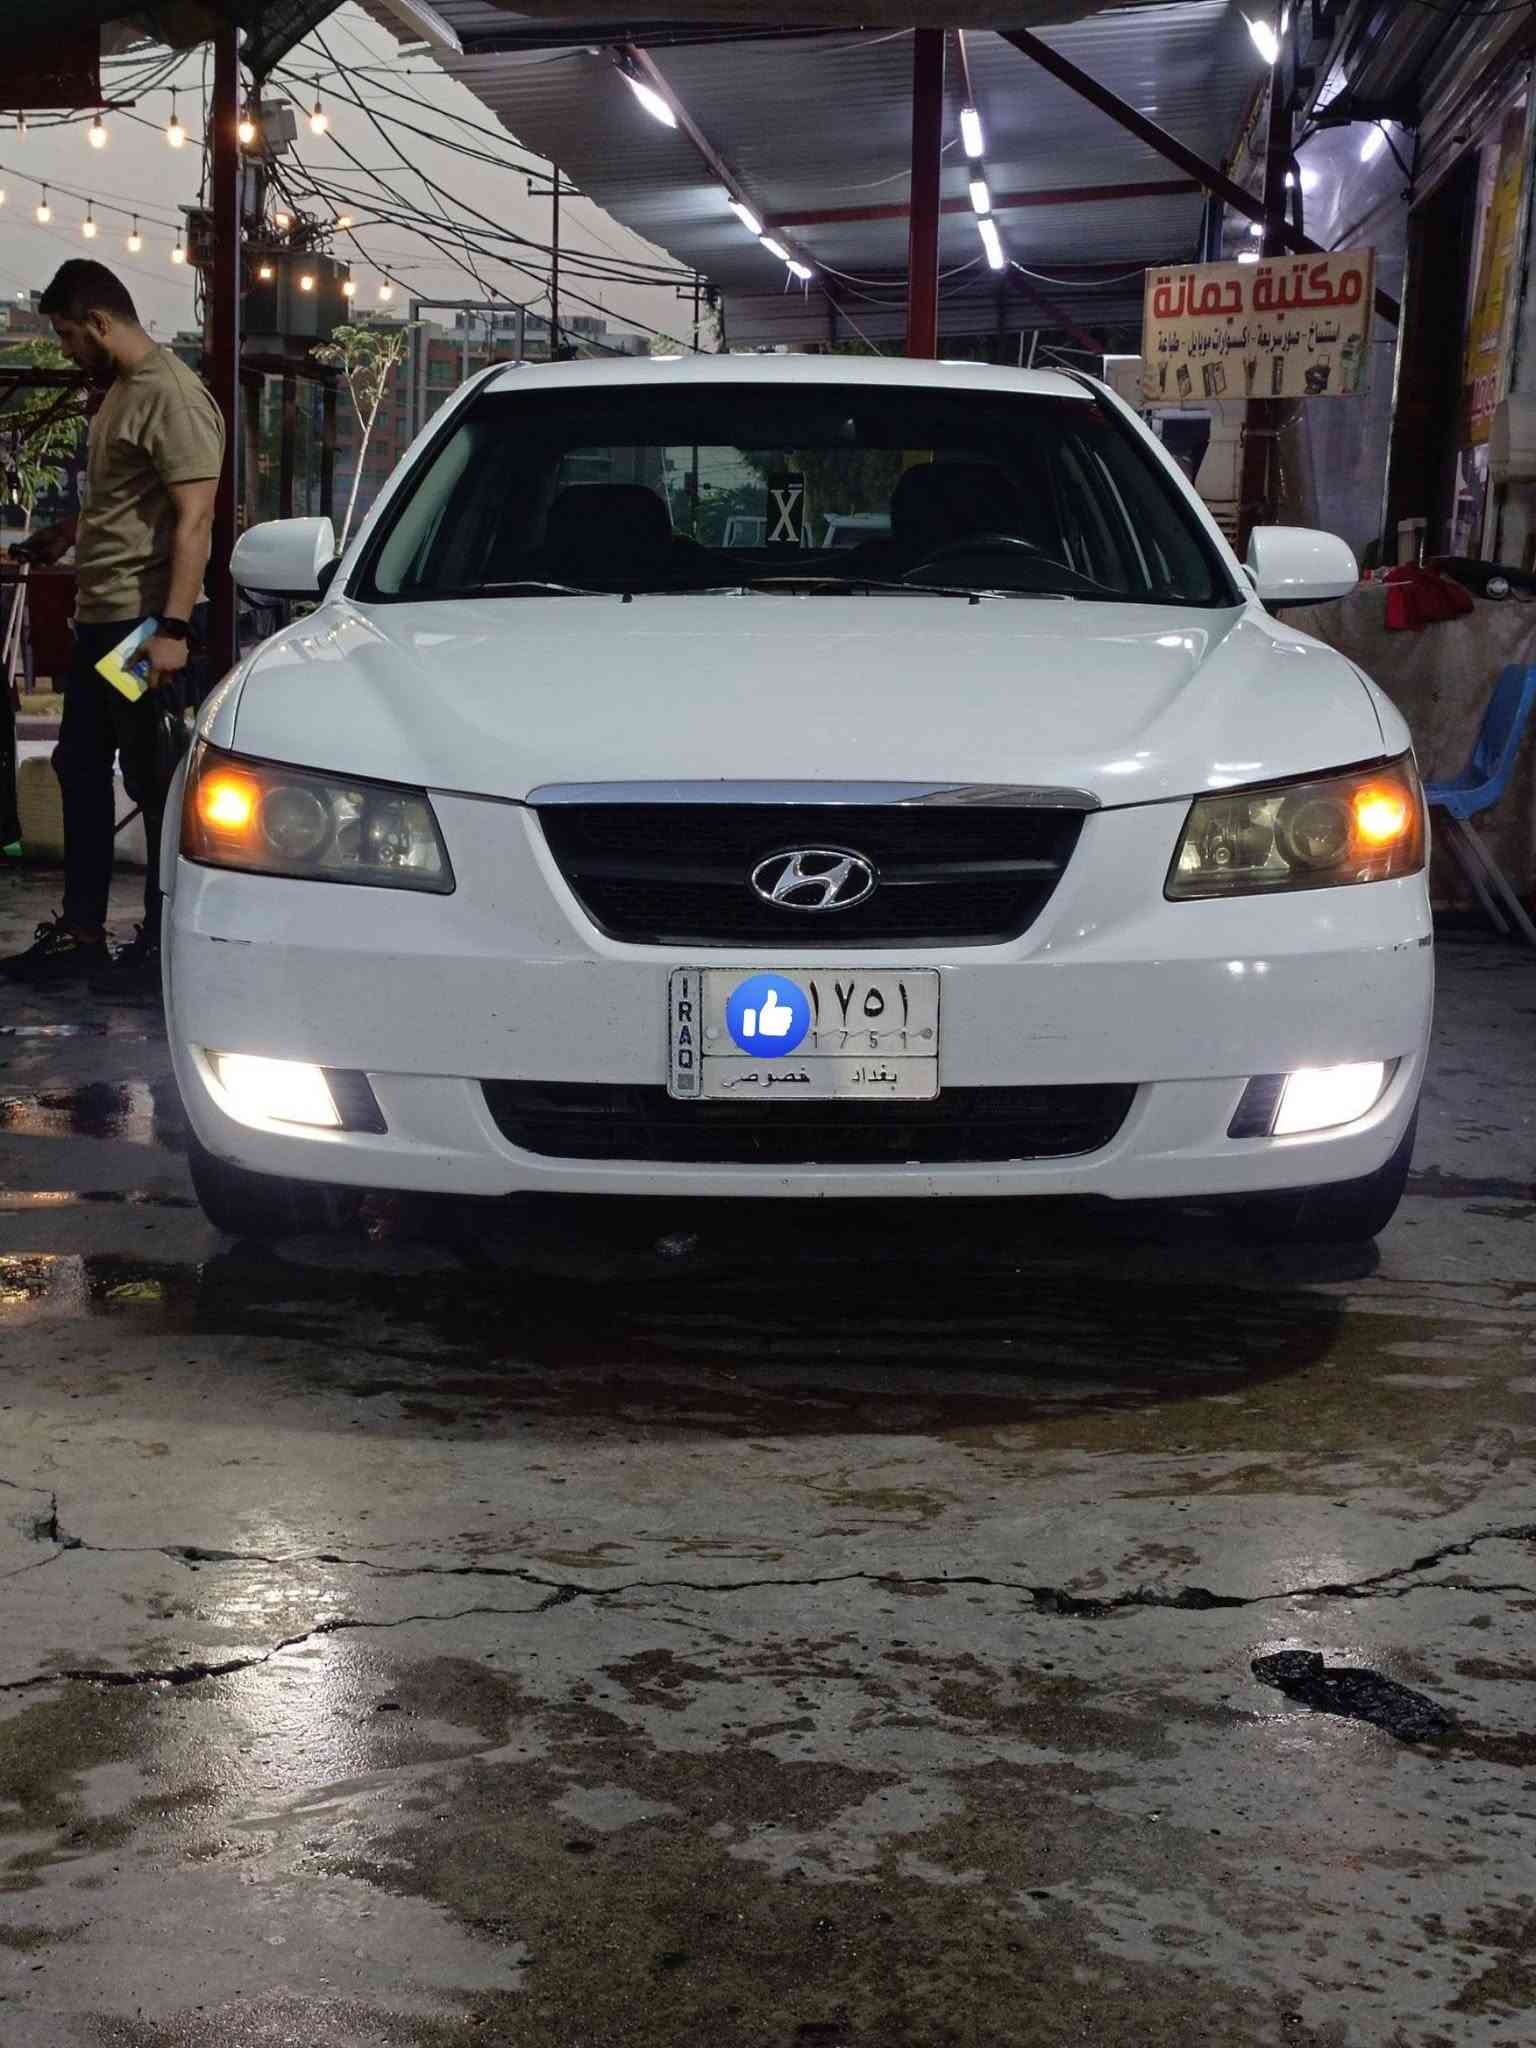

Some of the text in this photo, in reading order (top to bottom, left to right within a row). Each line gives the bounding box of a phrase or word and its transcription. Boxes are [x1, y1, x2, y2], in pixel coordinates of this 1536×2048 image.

[1153, 261, 1363, 325] مكتبة جمانة
[679, 976, 694, 1069] IRAQ
[851, 1063, 898, 1090] بغداد
